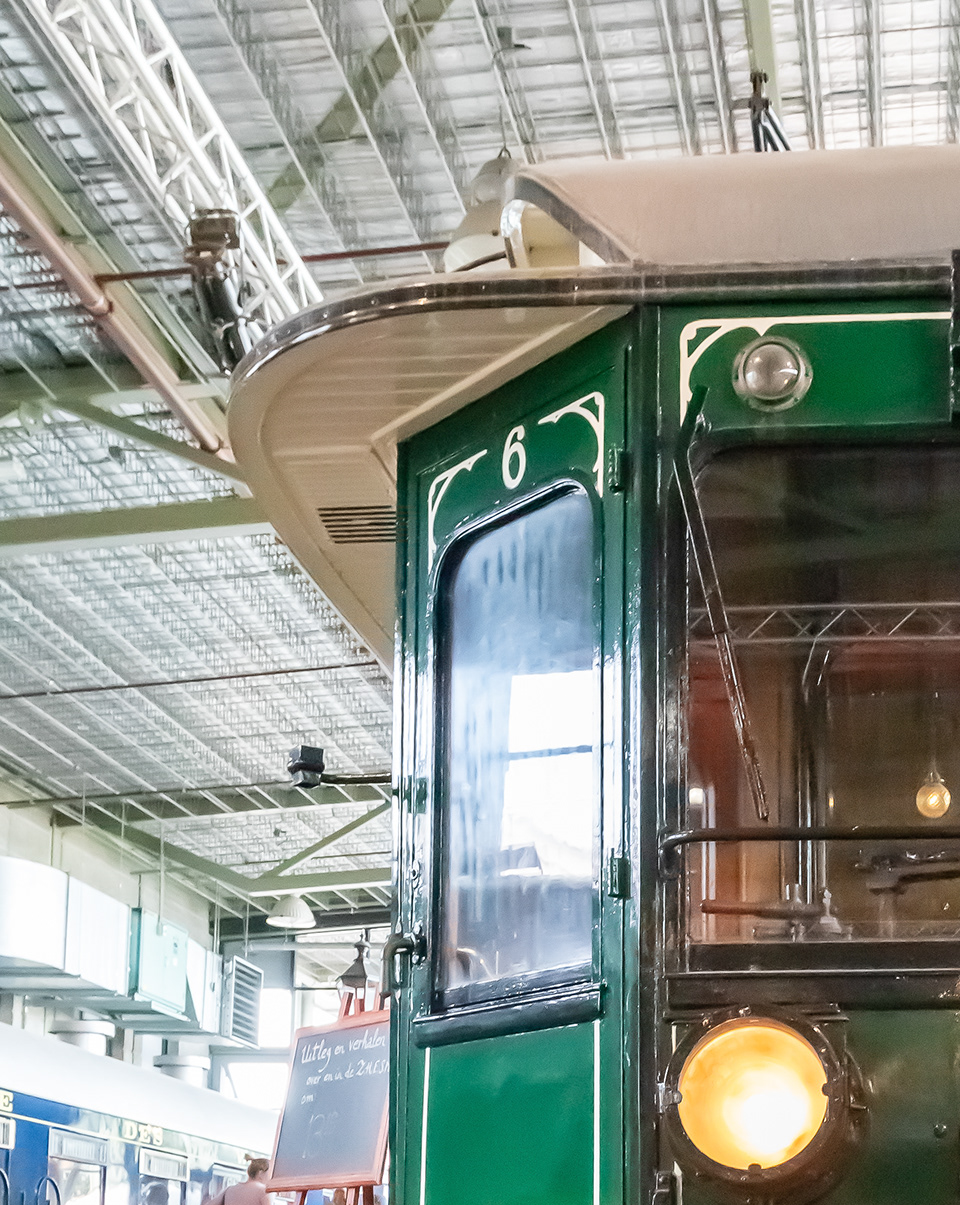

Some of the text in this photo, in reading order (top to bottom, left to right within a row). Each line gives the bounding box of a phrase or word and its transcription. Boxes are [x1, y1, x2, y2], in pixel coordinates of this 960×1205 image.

[502, 425, 526, 489] 6
[301, 1027, 385, 1073] Uitleg en verhalen
[306, 1075, 321, 1086] over
[324, 1073, 333, 1082] en
[334, 1068, 343, 1080] in
[344, 1062, 354, 1079] de
[301, 1094, 314, 1105] om
[123, 1119, 164, 1146] DES
